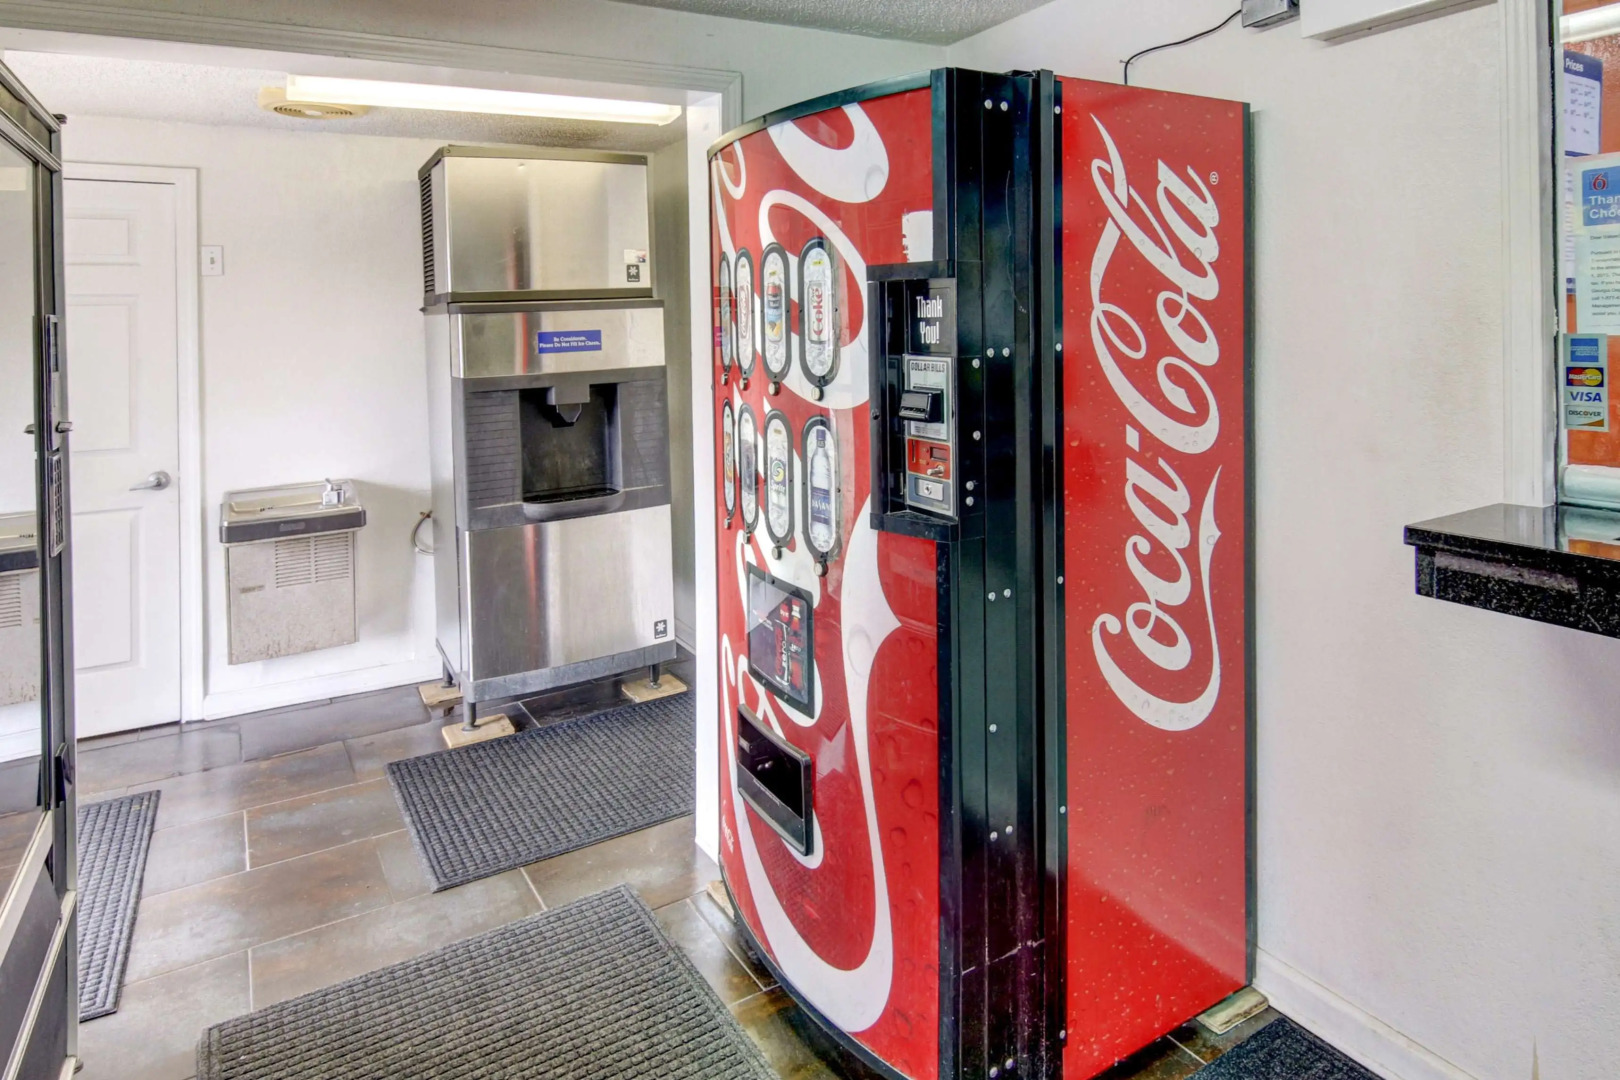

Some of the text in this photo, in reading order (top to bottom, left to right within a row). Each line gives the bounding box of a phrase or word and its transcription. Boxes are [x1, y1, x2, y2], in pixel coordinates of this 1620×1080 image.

[1565, 58, 1584, 72] Prices
[1592, 173, 1607, 191] 6
[813, 288, 823, 336] Coke
[916, 295, 943, 318] Thank
[920, 321, 940, 344] You!
[911, 362, 945, 373] DOLLAR BILLS
[1570, 391, 1602, 402] VISA
[1090, 112, 1221, 733] Coca-Cola
